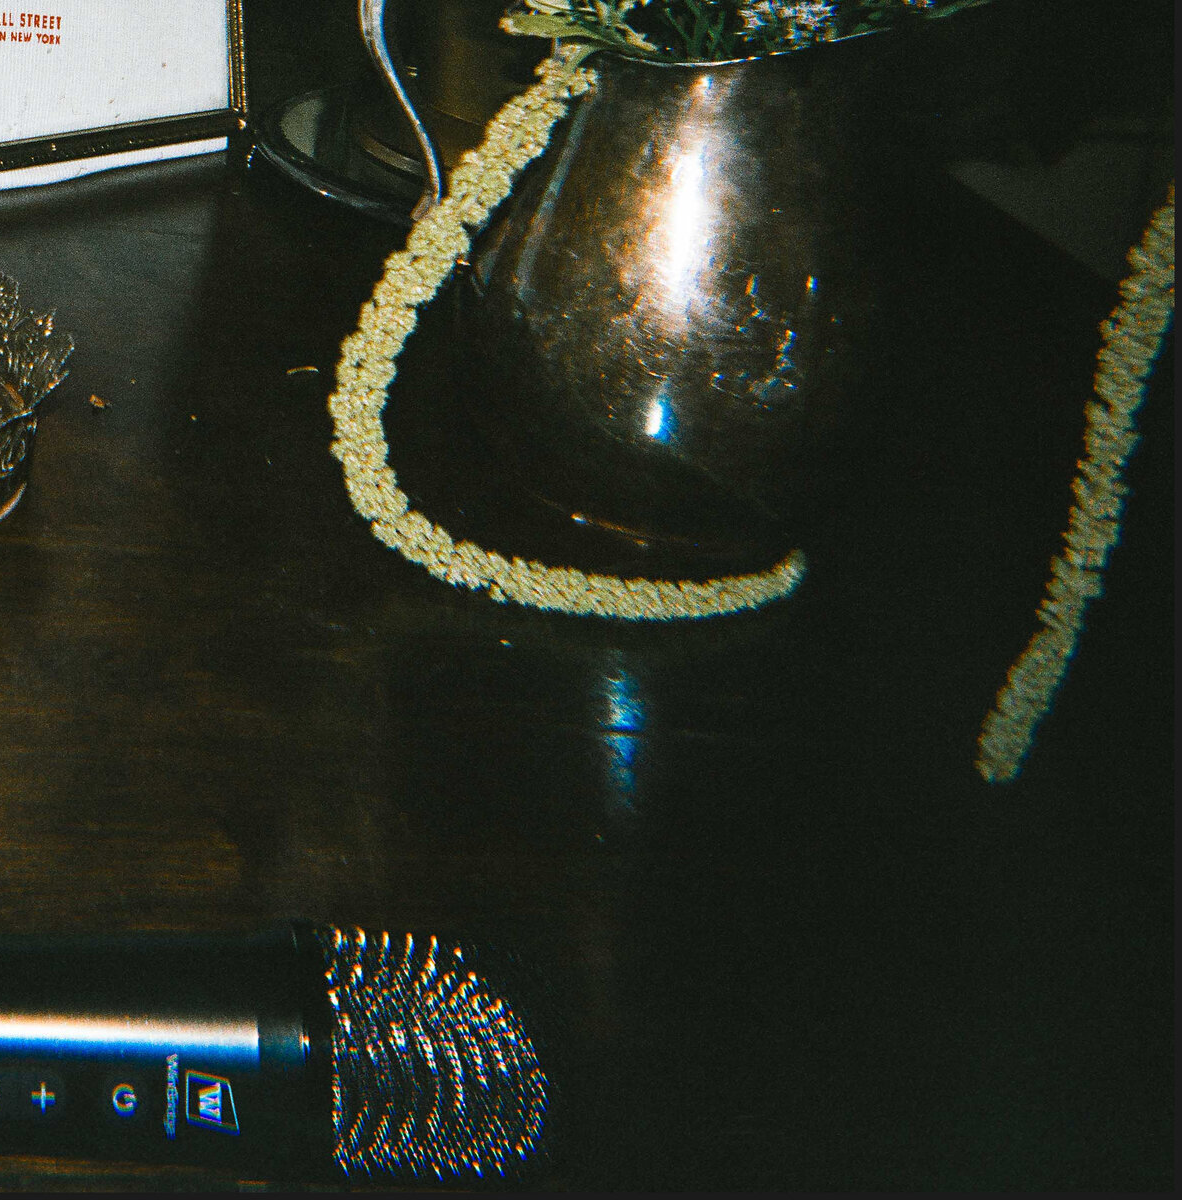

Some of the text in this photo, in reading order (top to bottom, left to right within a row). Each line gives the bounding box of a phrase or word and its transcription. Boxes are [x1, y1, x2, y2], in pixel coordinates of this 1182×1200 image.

[20, 13, 62, 31] STREET
[11, 31, 32, 44] NEW
[36, 32, 61, 46] YORK
